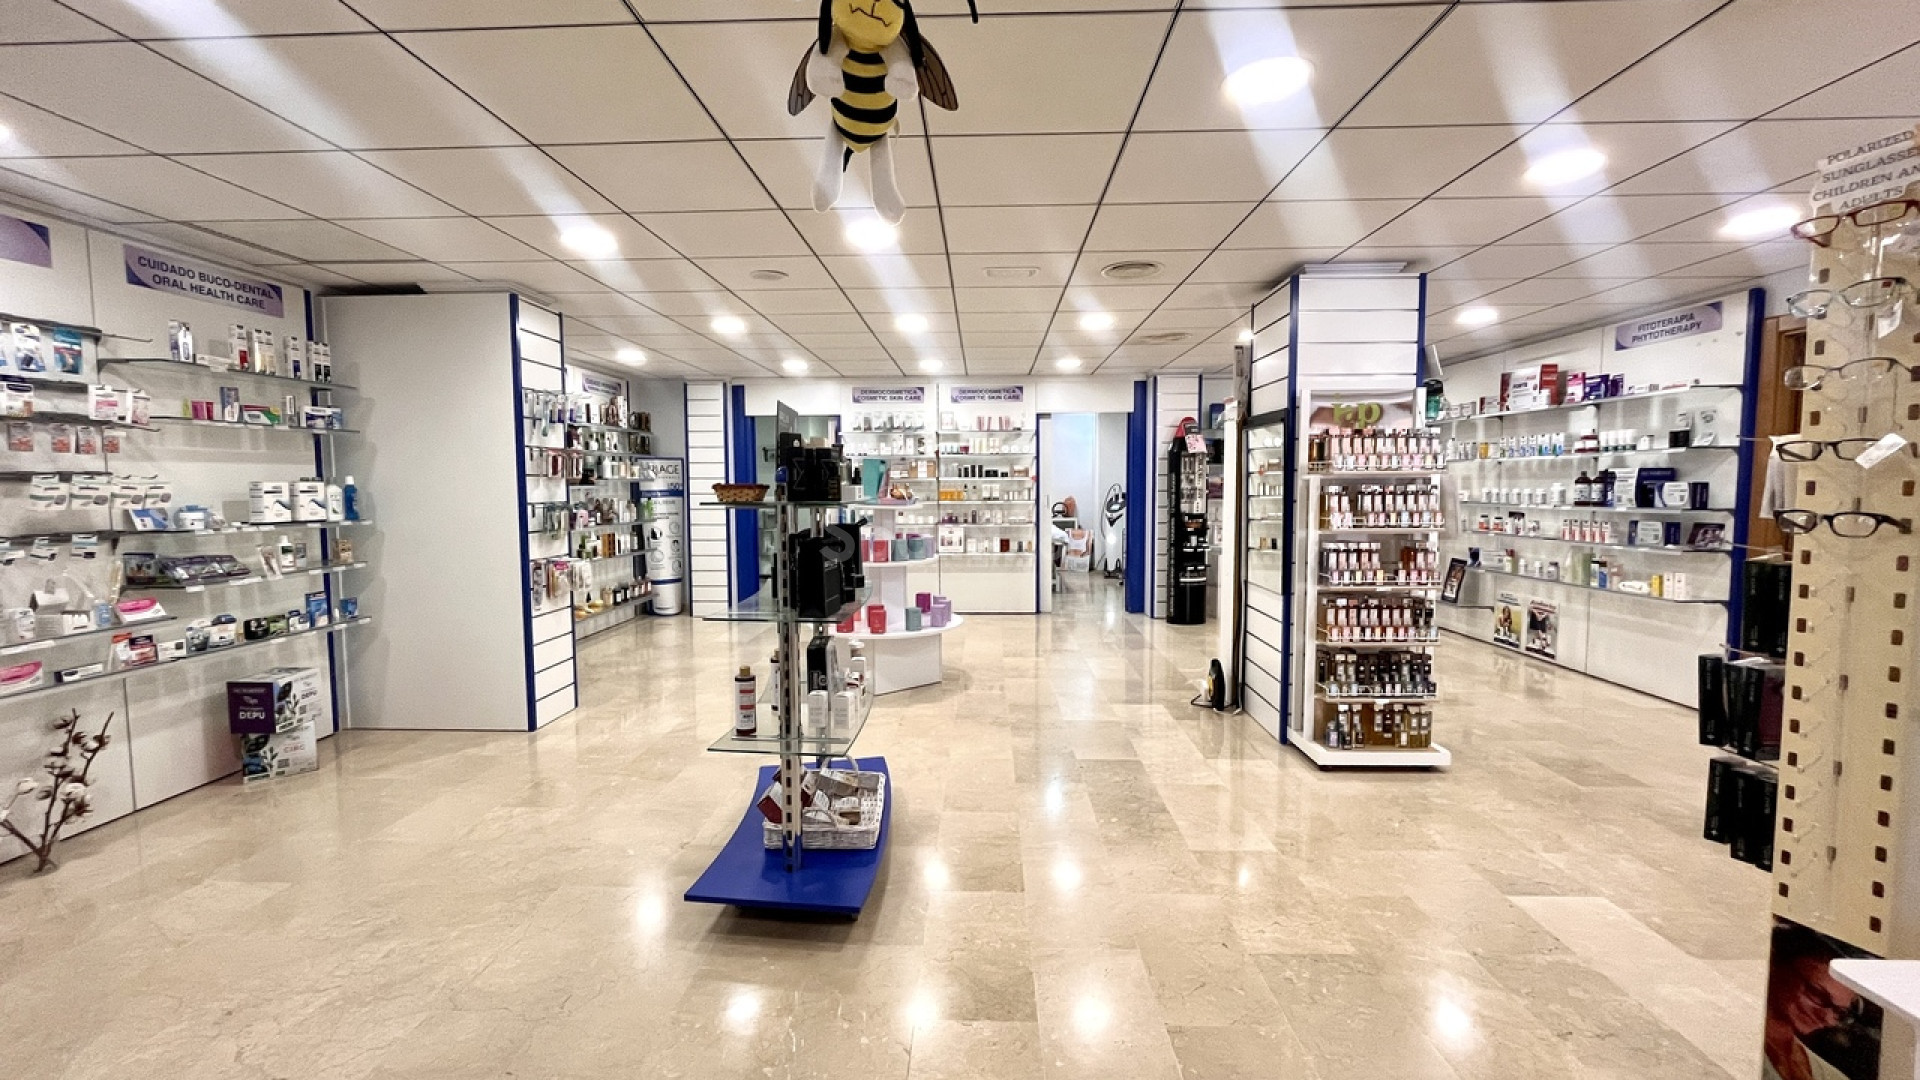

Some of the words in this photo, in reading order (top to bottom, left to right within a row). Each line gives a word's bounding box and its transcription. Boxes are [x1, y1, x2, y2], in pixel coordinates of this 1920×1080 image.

[1827, 130, 1915, 165] POLARIZED
[1813, 172, 1893, 201] CHILDREN
[1897, 164, 1920, 179] AN
[1839, 185, 1904, 210] ADULTS
[137, 256, 196, 280] CUIDADO
[198, 271, 275, 300] BUCO-DENTAL
[152, 274, 188, 292] ORAL
[190, 283, 235, 302] HEALTH
[237, 295, 267, 310] CARE
[1631, 321, 1703, 343] PHYTOTHERAPY
[1637, 312, 1696, 333] FITOTERAPIA
[239, 711, 266, 720] DEPU
